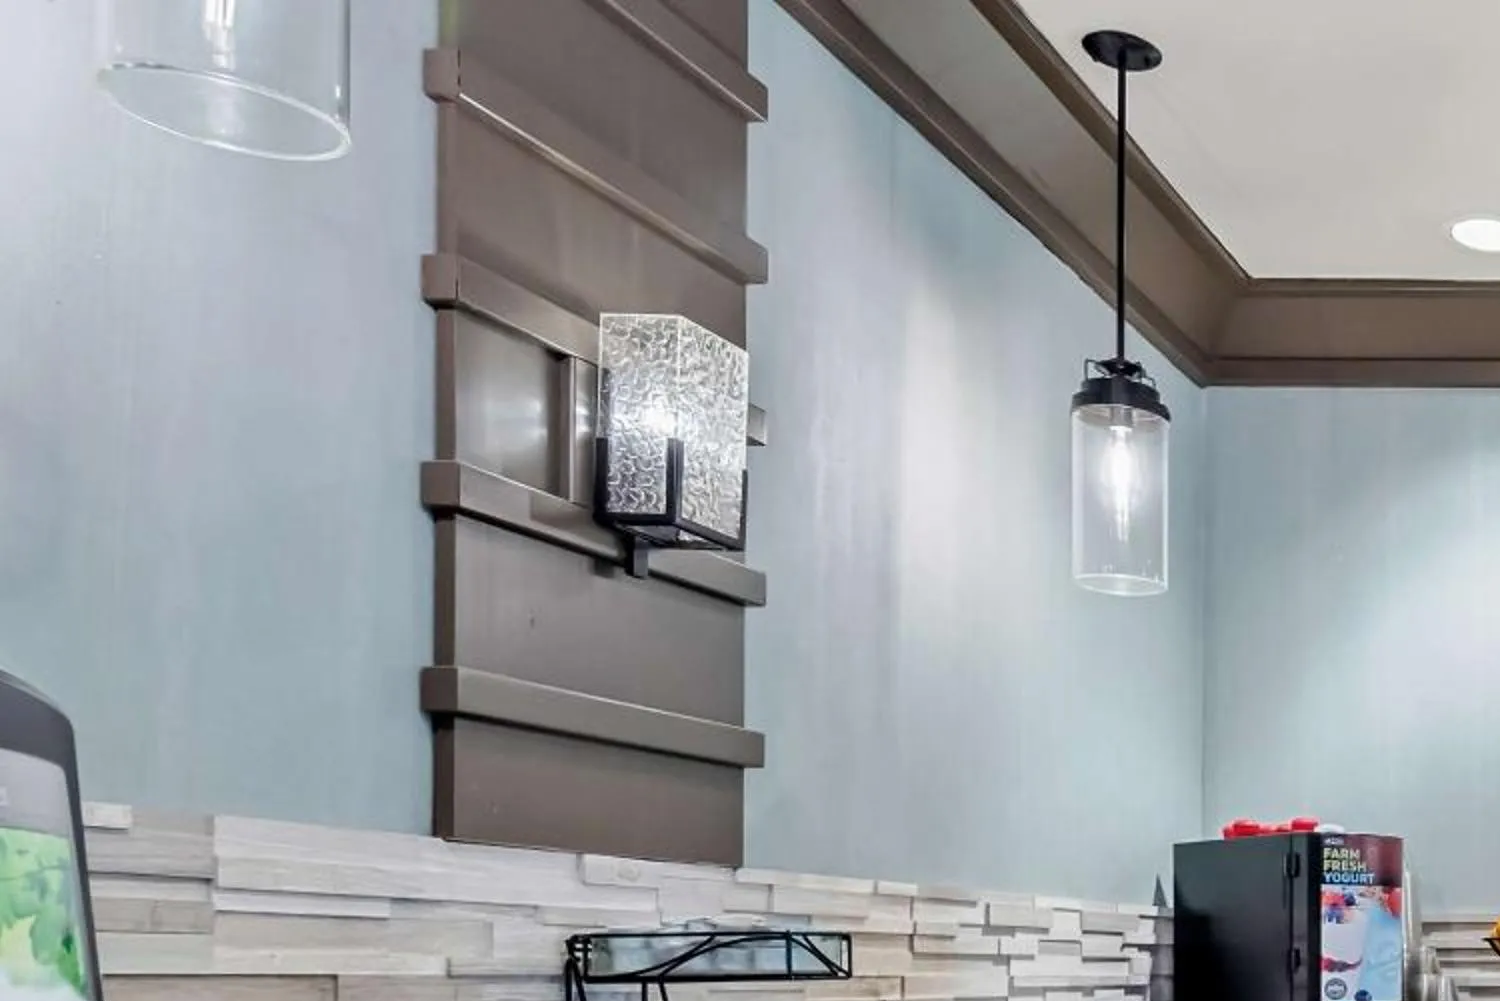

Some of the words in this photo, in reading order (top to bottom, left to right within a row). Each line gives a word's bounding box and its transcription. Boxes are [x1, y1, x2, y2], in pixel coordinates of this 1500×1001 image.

[1323, 847, 1360, 860] FARM
[1323, 859, 1367, 872] FRESH
[1323, 871, 1375, 884] YOGURT
